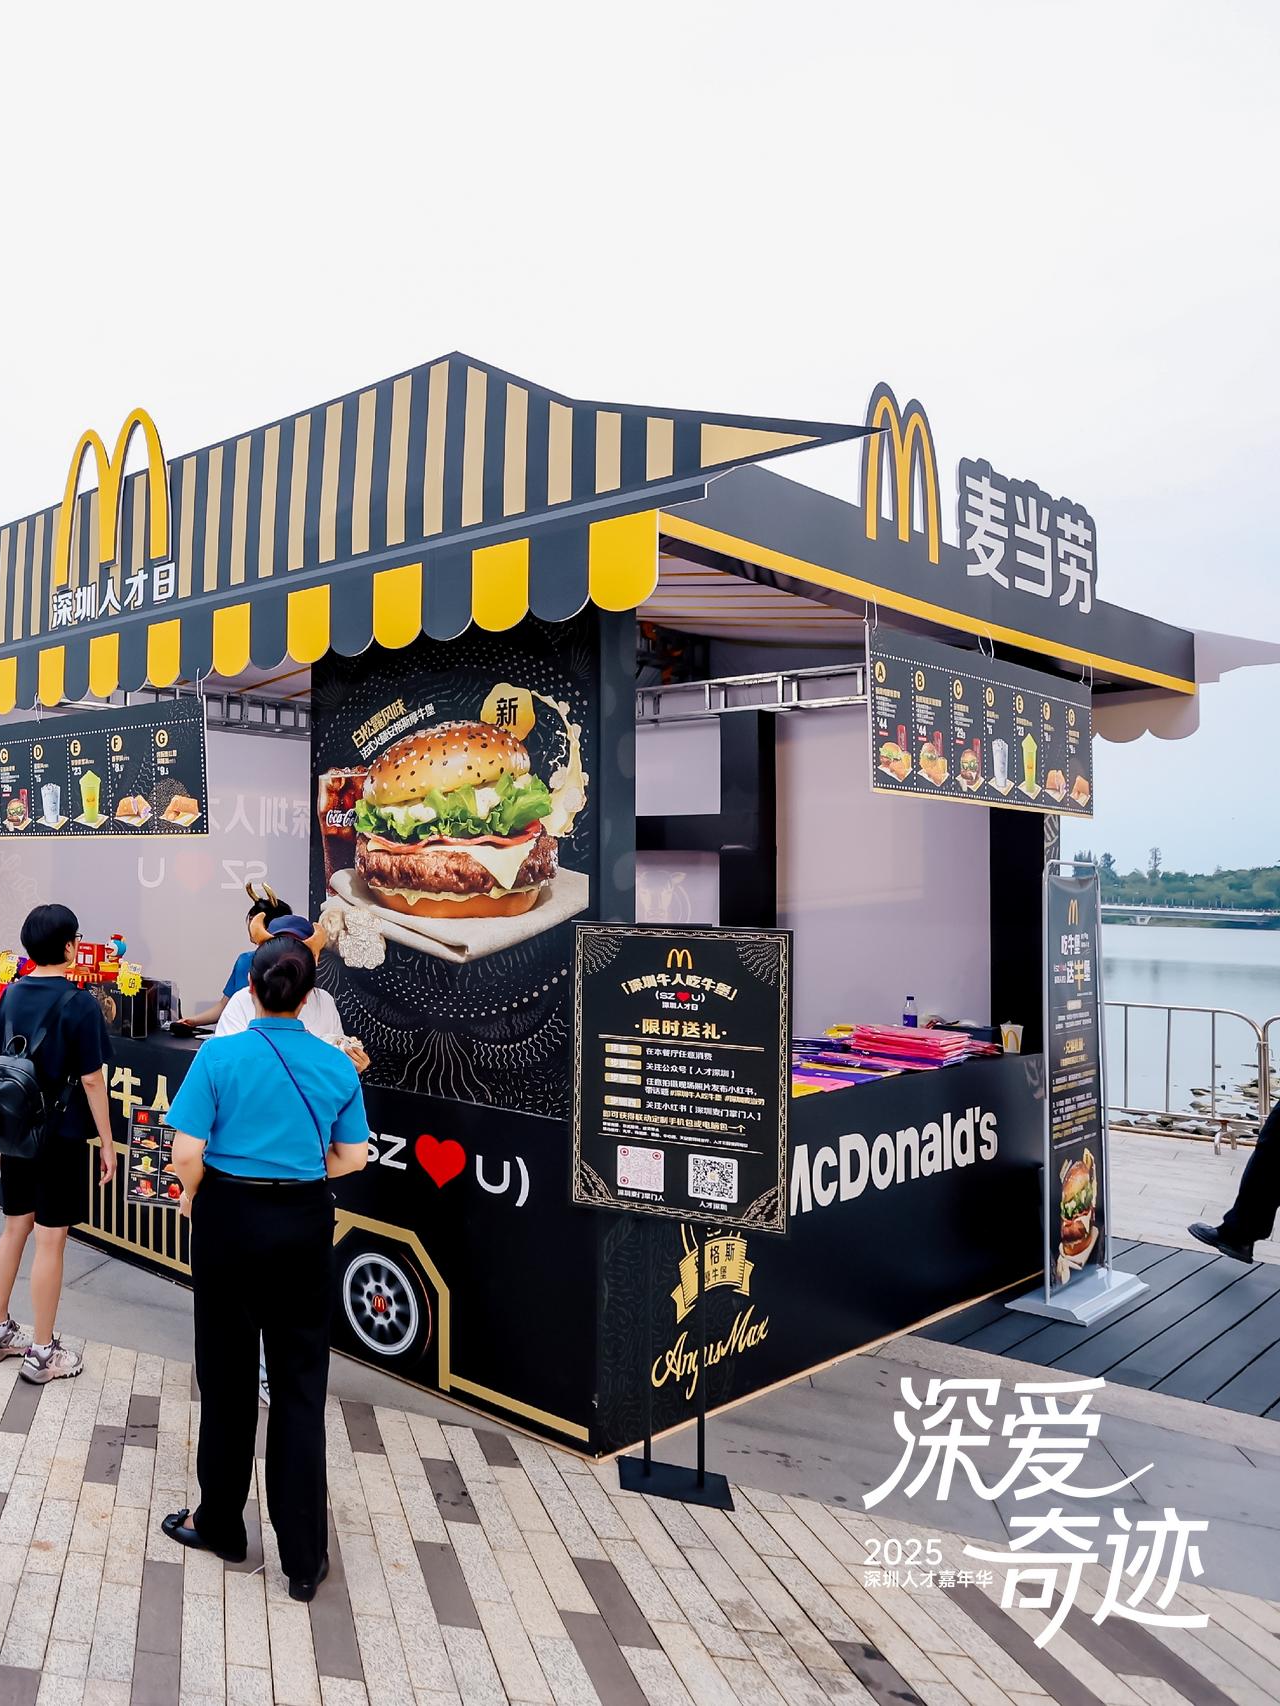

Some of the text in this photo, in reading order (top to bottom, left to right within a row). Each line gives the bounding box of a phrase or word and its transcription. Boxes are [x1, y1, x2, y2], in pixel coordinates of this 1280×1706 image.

[965, 475, 1093, 614] 麦当劳
[51, 562, 176, 629] 深圳人才日
[351, 698, 408, 749] 白松露风味
[495, 697, 519, 727] 新
